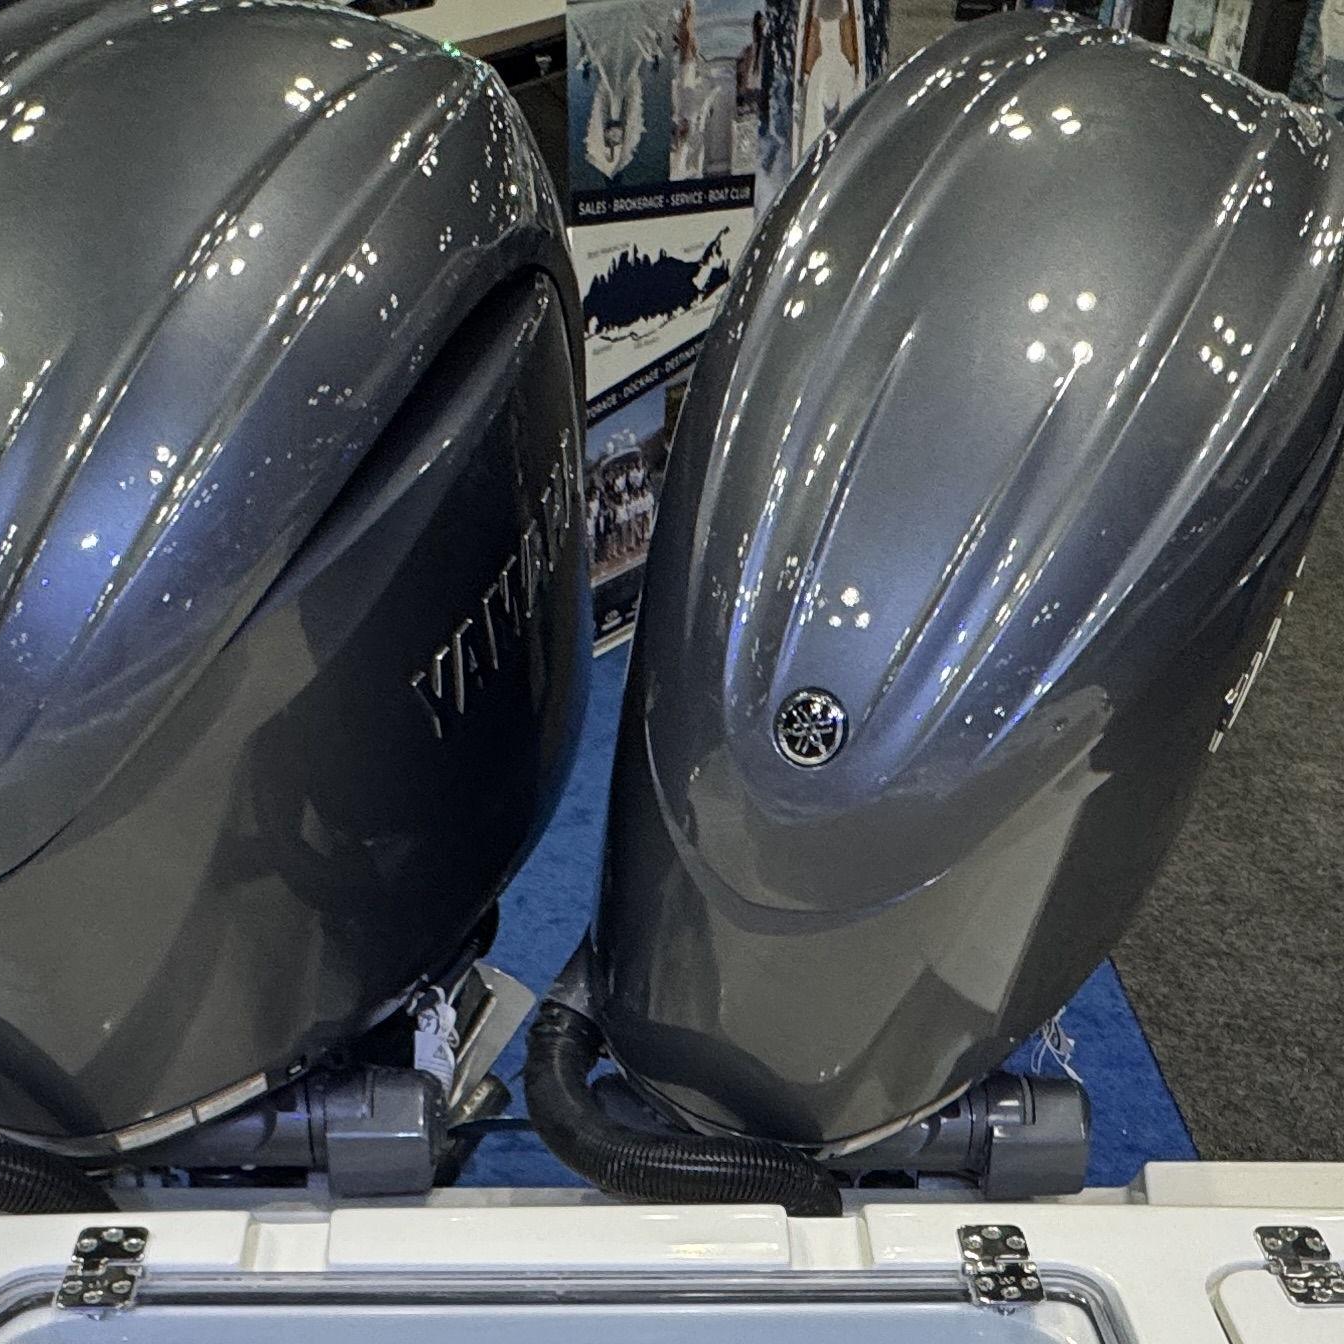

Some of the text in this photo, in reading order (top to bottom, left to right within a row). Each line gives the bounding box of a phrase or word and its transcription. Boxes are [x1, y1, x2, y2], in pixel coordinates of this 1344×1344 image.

[577, 186, 752, 216] SALES BROKERAGE SERVICE BOAT CLUB
